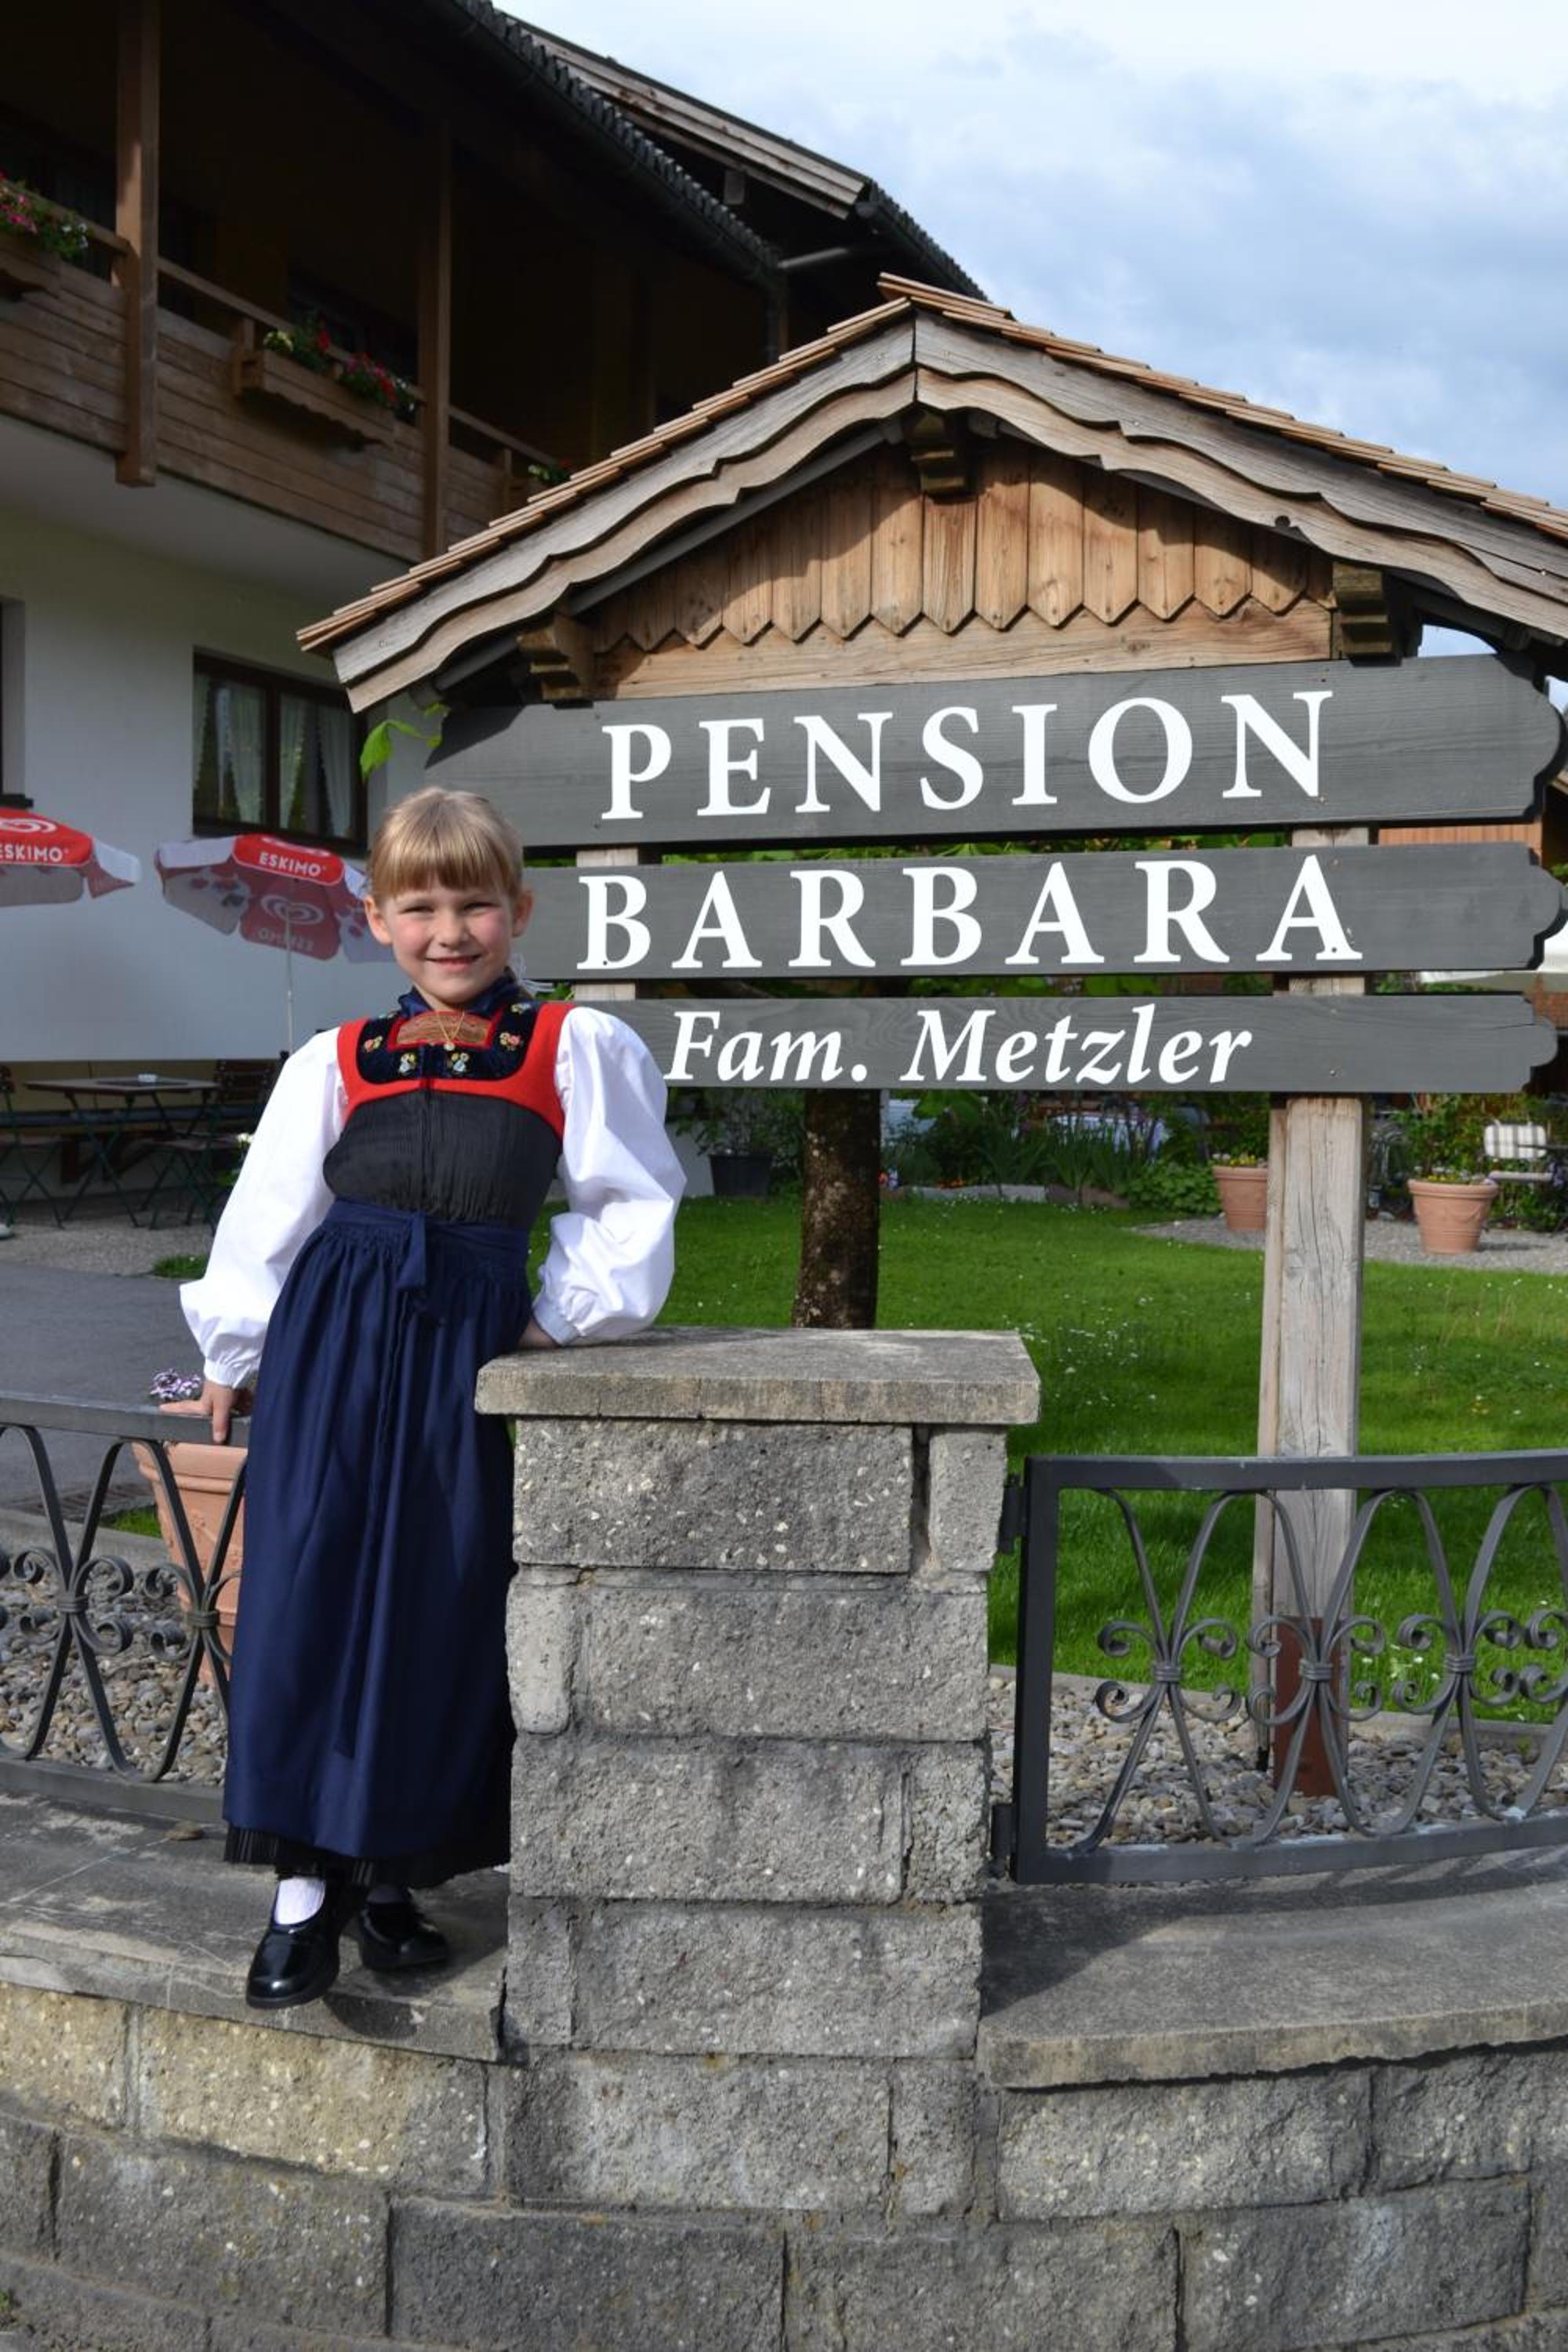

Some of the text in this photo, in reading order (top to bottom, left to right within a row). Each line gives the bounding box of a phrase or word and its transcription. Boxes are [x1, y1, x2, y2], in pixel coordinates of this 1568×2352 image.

[601, 689, 1334, 821] PENSION
[258, 851, 321, 877] ESKIMO
[576, 853, 1364, 971] BARBARA
[662, 1002, 1254, 1085] Fam. Metzler
